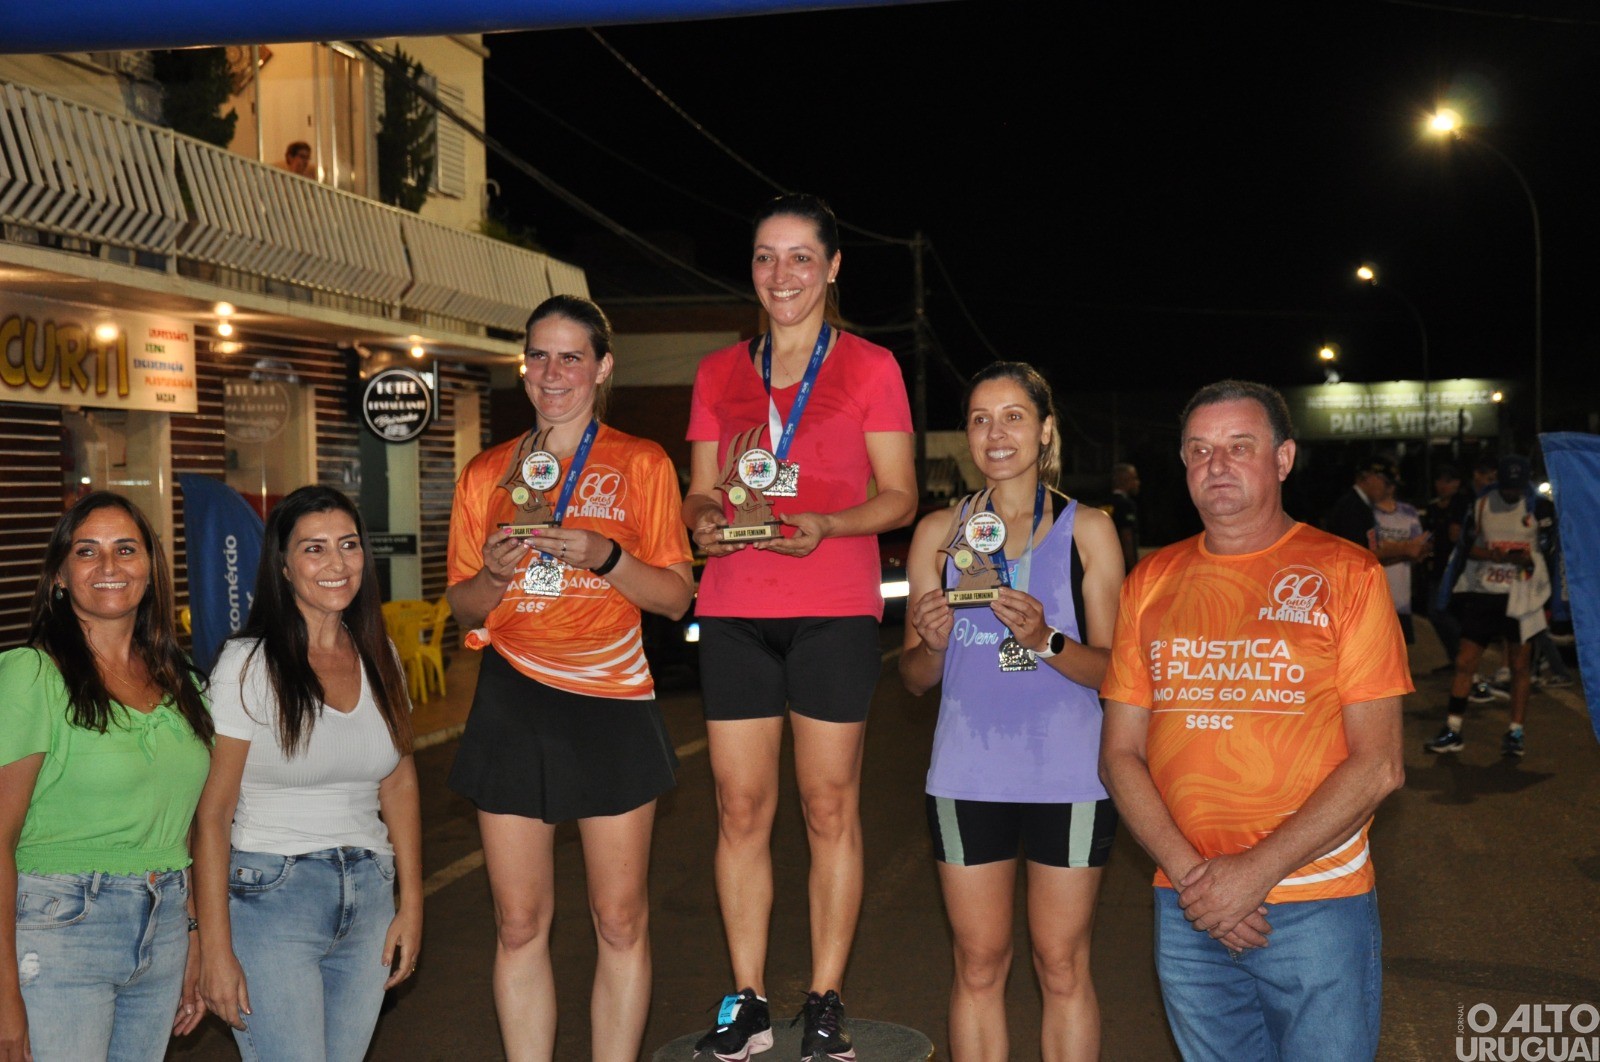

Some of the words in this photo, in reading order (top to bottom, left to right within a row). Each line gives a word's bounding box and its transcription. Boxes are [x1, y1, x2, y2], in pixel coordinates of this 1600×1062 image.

[0, 315, 130, 396] CURTI
[566, 504, 626, 522] PLANALTO
[1258, 606, 1330, 628] PLANALTO
[954, 618, 999, 648] Vem
[1172, 636, 1291, 660] RÚSTICA
[1167, 661, 1305, 683] PLANALTO
[1153, 687, 1174, 702] MO
[1176, 687, 1215, 702] AOS
[1250, 687, 1306, 704] ANOS
[1185, 713, 1234, 730] sesc
